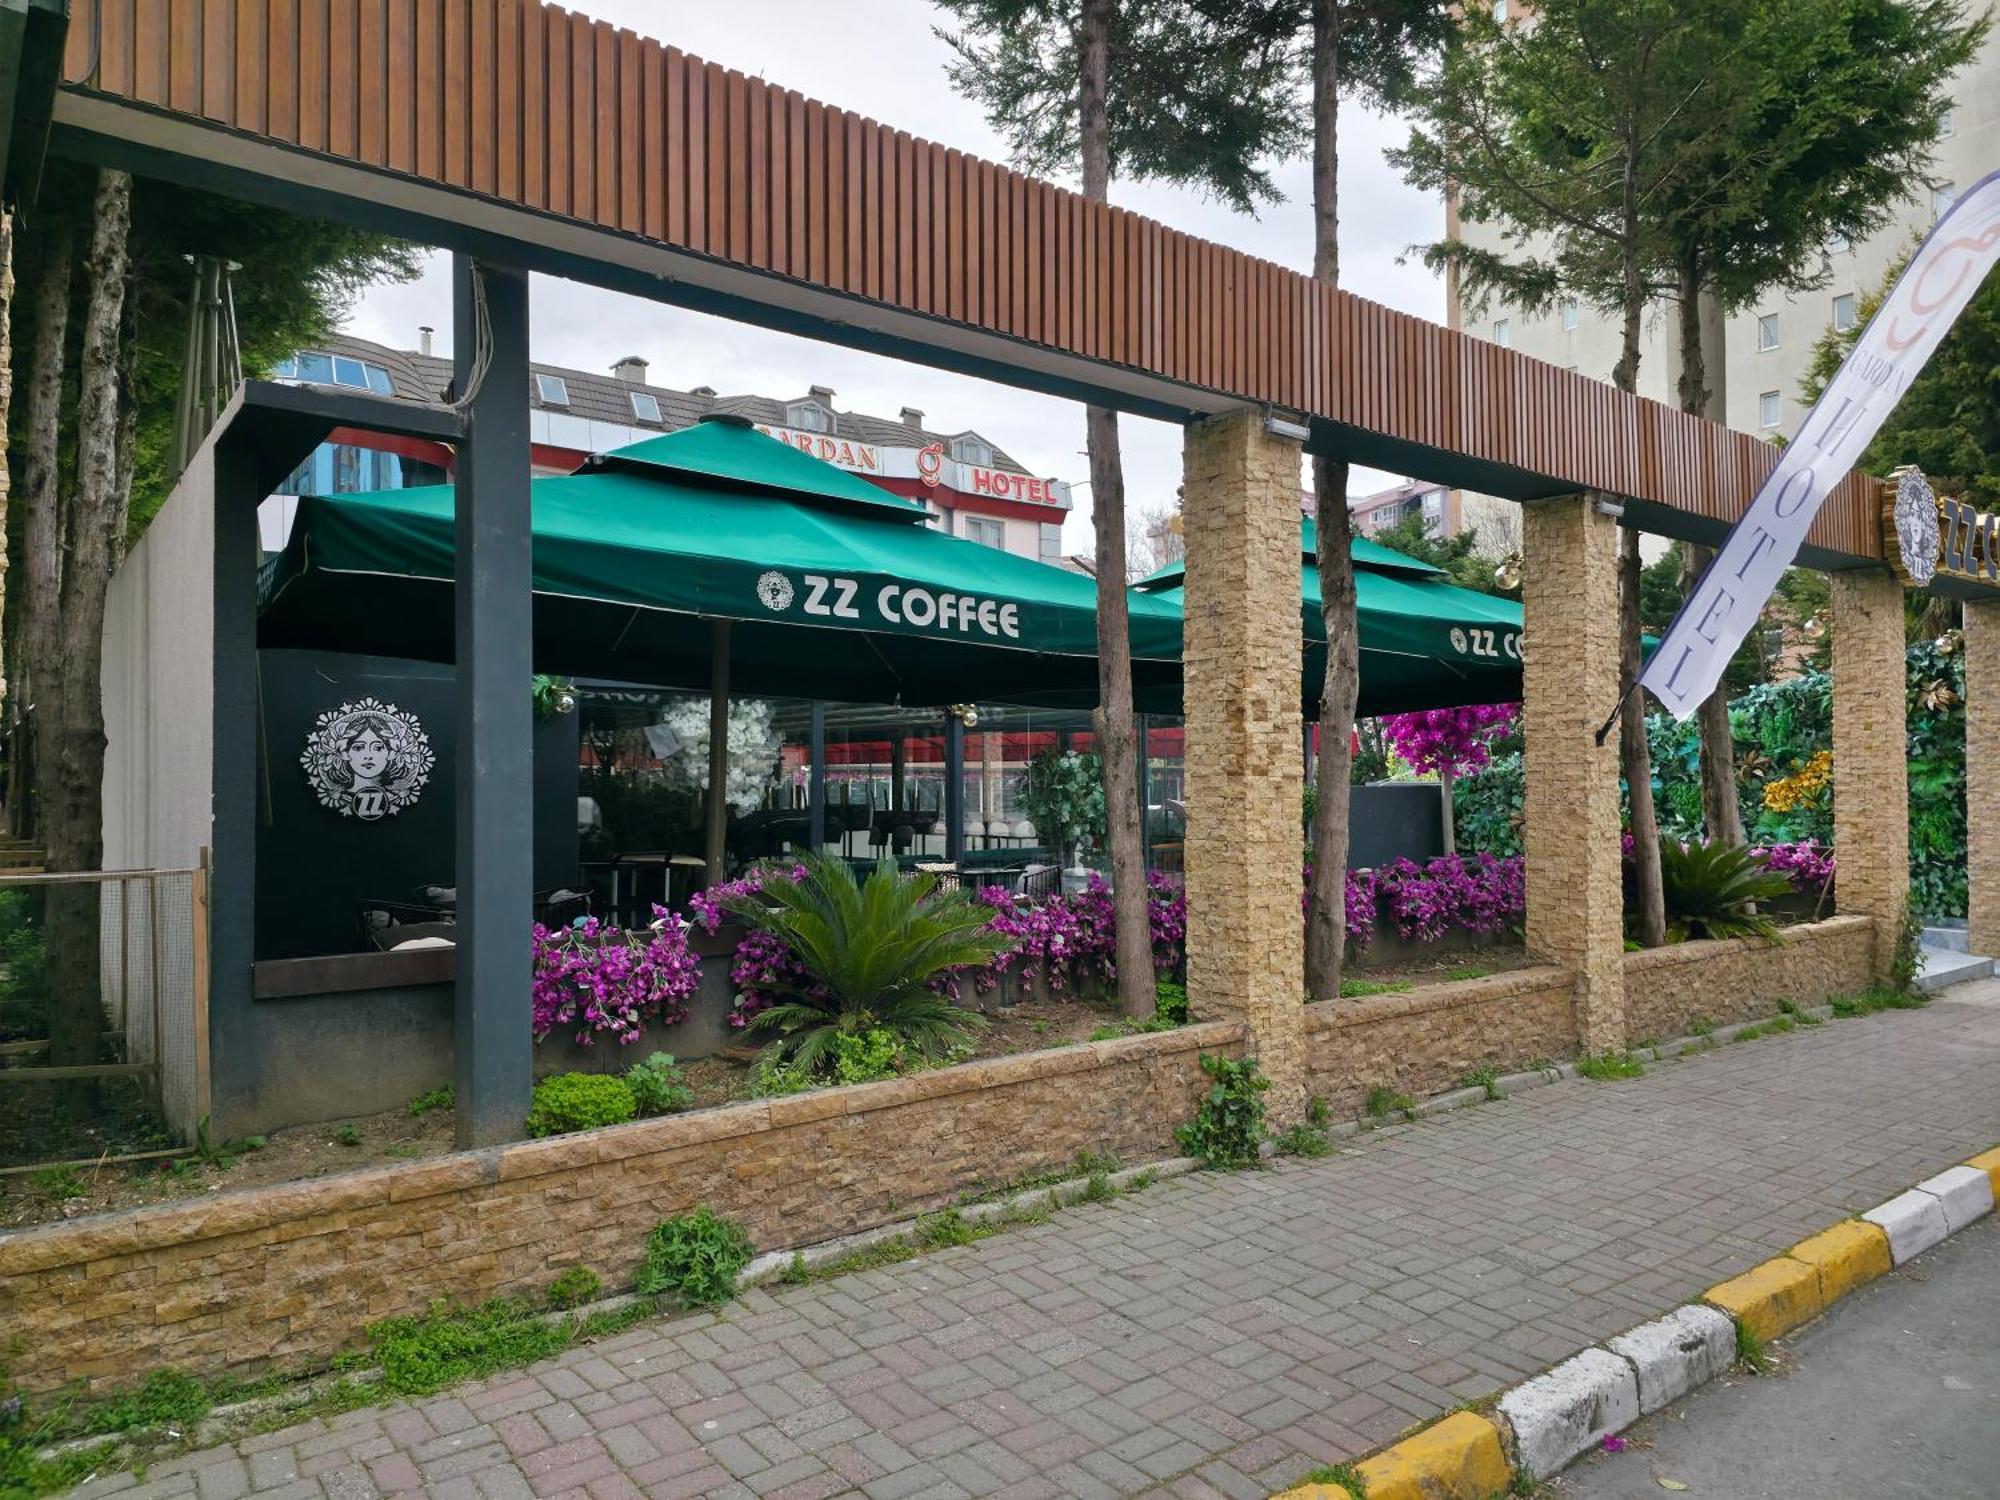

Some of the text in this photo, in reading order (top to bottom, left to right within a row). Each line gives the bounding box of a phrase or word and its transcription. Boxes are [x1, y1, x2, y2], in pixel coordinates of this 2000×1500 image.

[760, 424, 876, 470] ARDAN
[973, 468, 1057, 505] HOTEL
[1666, 396, 1868, 702] HOTEL
[1941, 496, 2000, 583] ZZ C
[803, 575, 1020, 639] ZZ COFFEE
[1469, 629, 1499, 657] ZZ
[357, 793, 384, 817] ZZ
